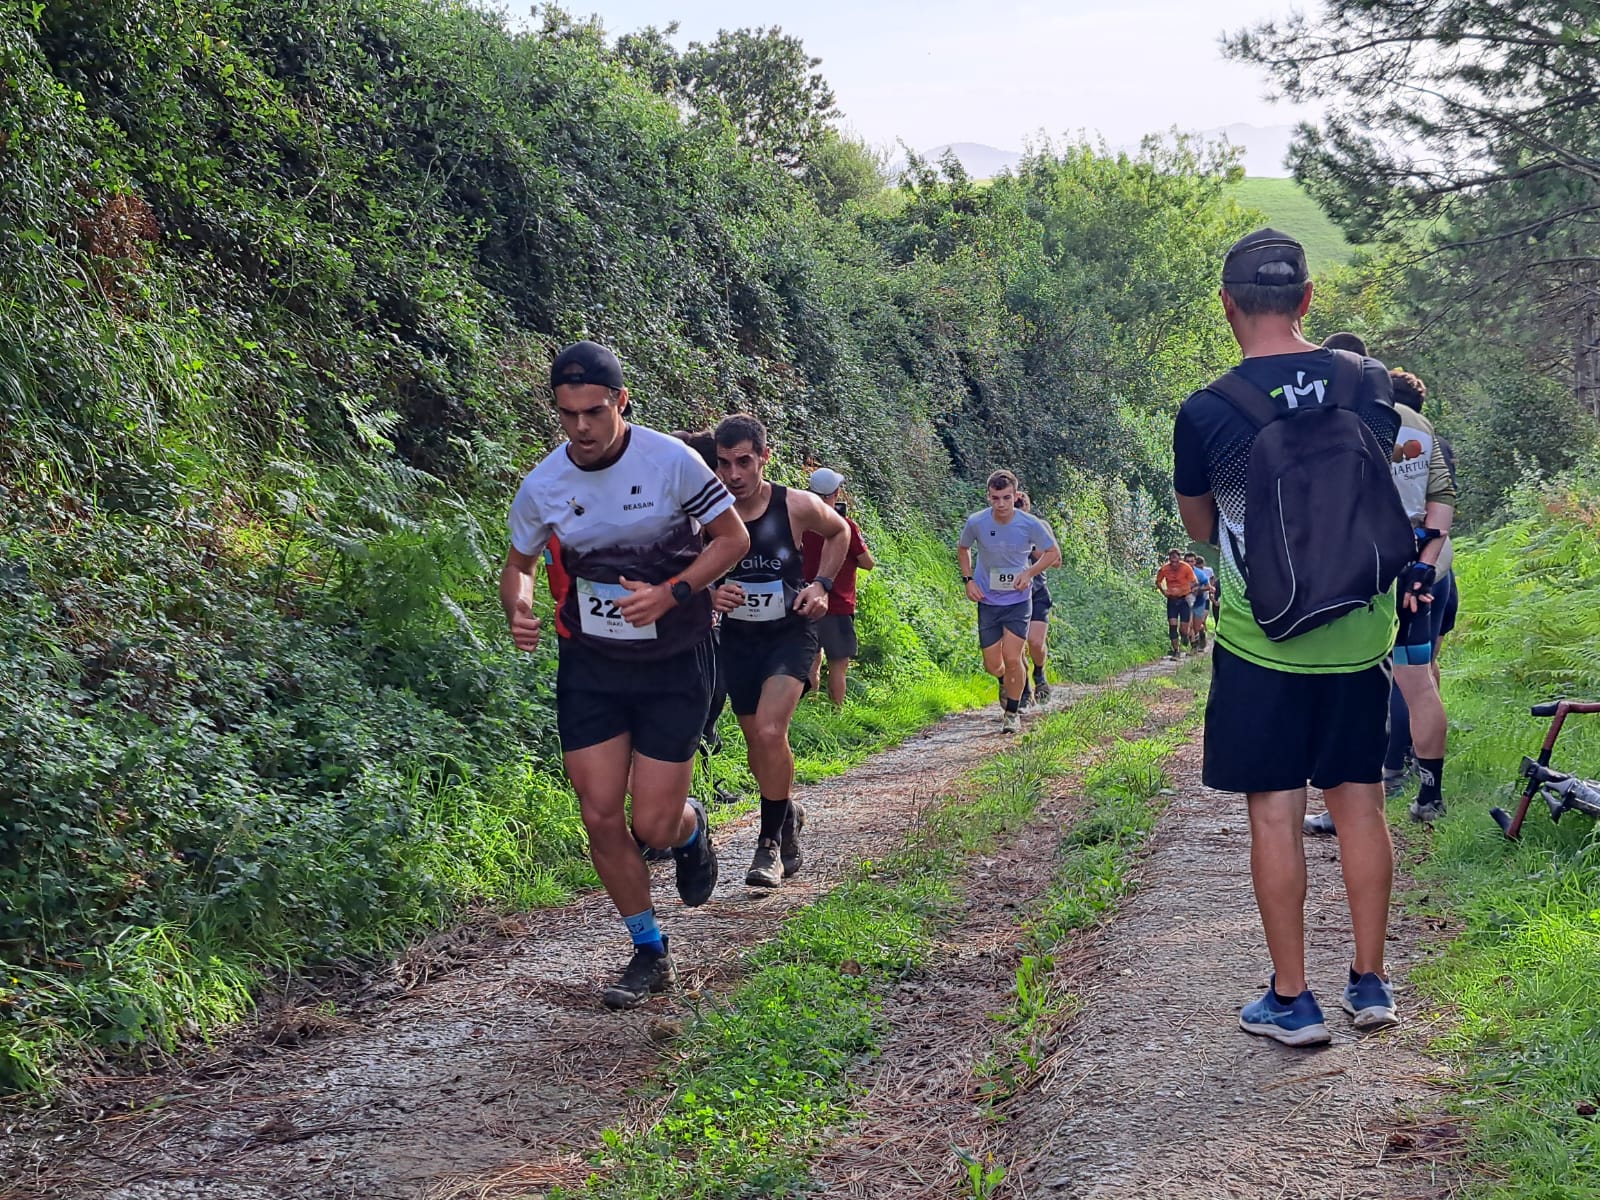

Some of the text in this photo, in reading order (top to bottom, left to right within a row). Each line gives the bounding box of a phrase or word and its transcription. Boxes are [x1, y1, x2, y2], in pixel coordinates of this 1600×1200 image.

[623, 497, 654, 511] BEASAIN
[741, 555, 782, 570] aike
[999, 573, 1014, 583] 89
[742, 593, 773, 608] 57
